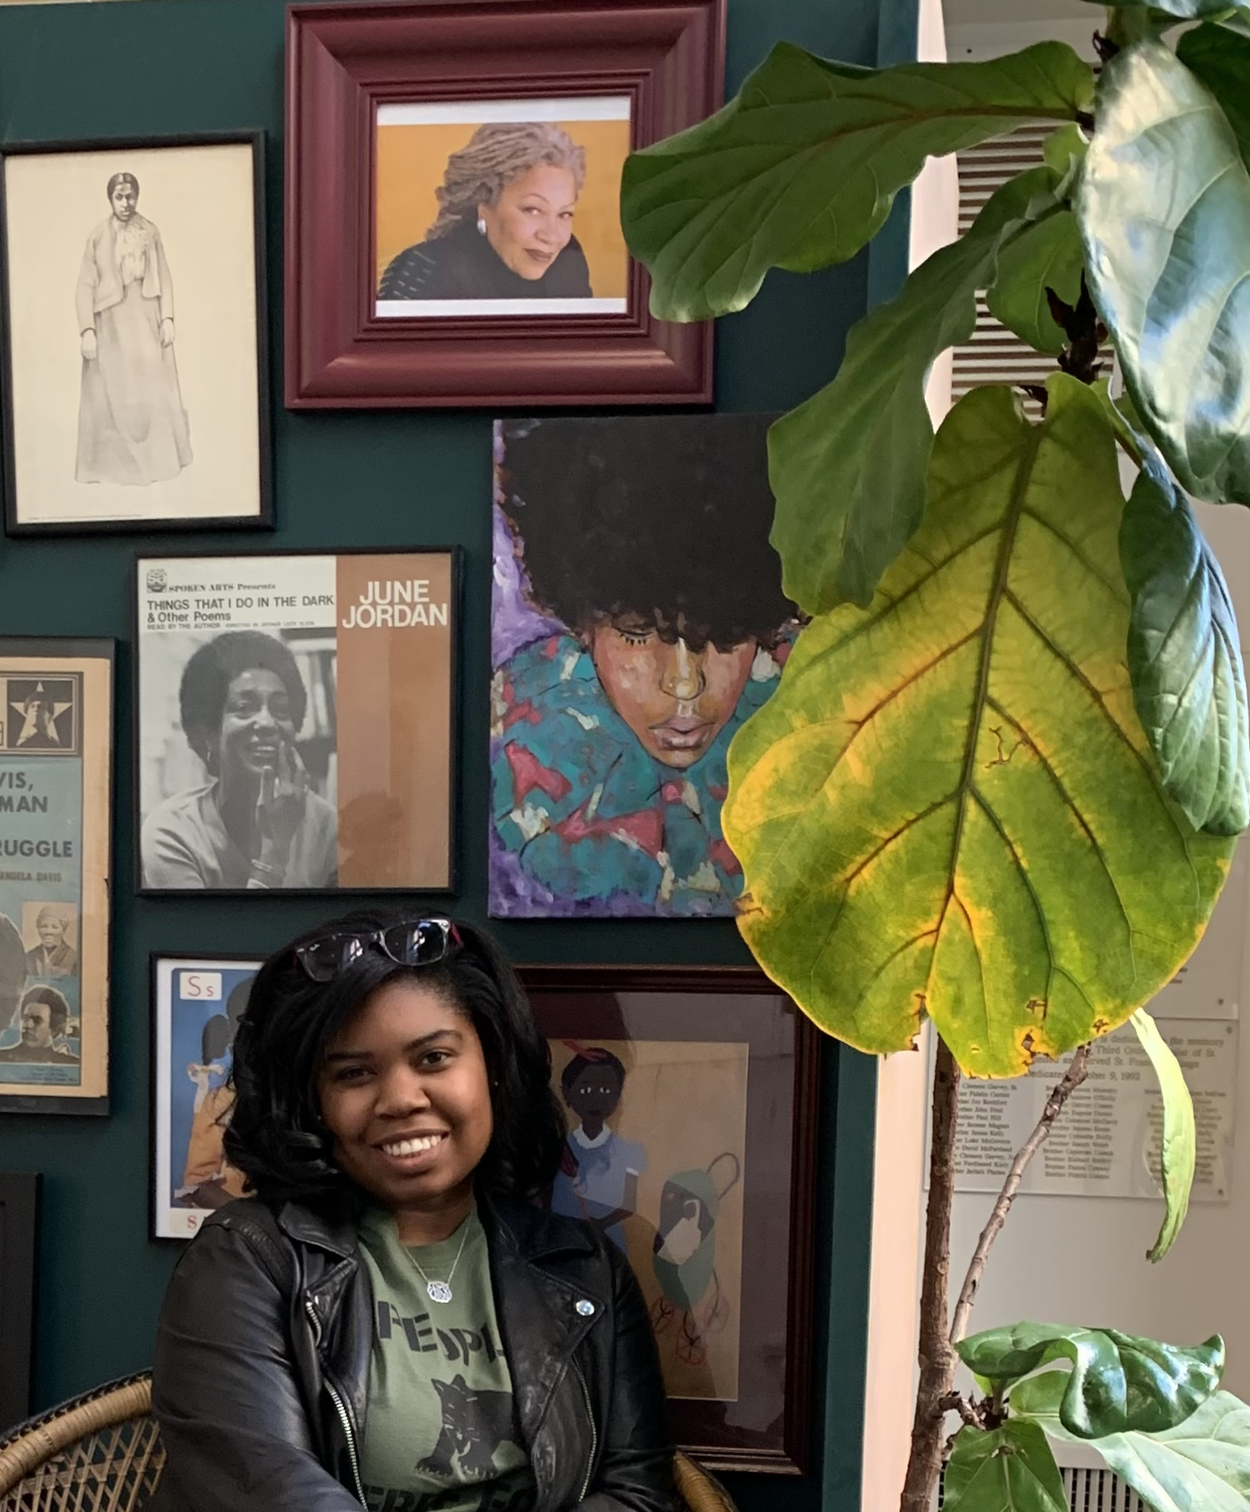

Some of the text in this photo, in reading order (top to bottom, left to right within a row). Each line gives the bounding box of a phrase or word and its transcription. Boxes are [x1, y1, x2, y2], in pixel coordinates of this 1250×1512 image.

[169, 583, 276, 593] SPOKEN ARTS Presents
[359, 579, 430, 605] JUNE
[147, 594, 335, 610] THINGS THAT I DO IN THE DARK
[147, 611, 231, 623] & Other Poems
[341, 603, 448, 629] JORDAN
[0, 871, 33, 881] ANGELA
[36, 872, 62, 882] DAVIS
[1170, 1037, 1224, 1047] the memory
[1097, 1046, 1121, 1055] Third
[1110, 1072, 1141, 1081] 9, 1992
